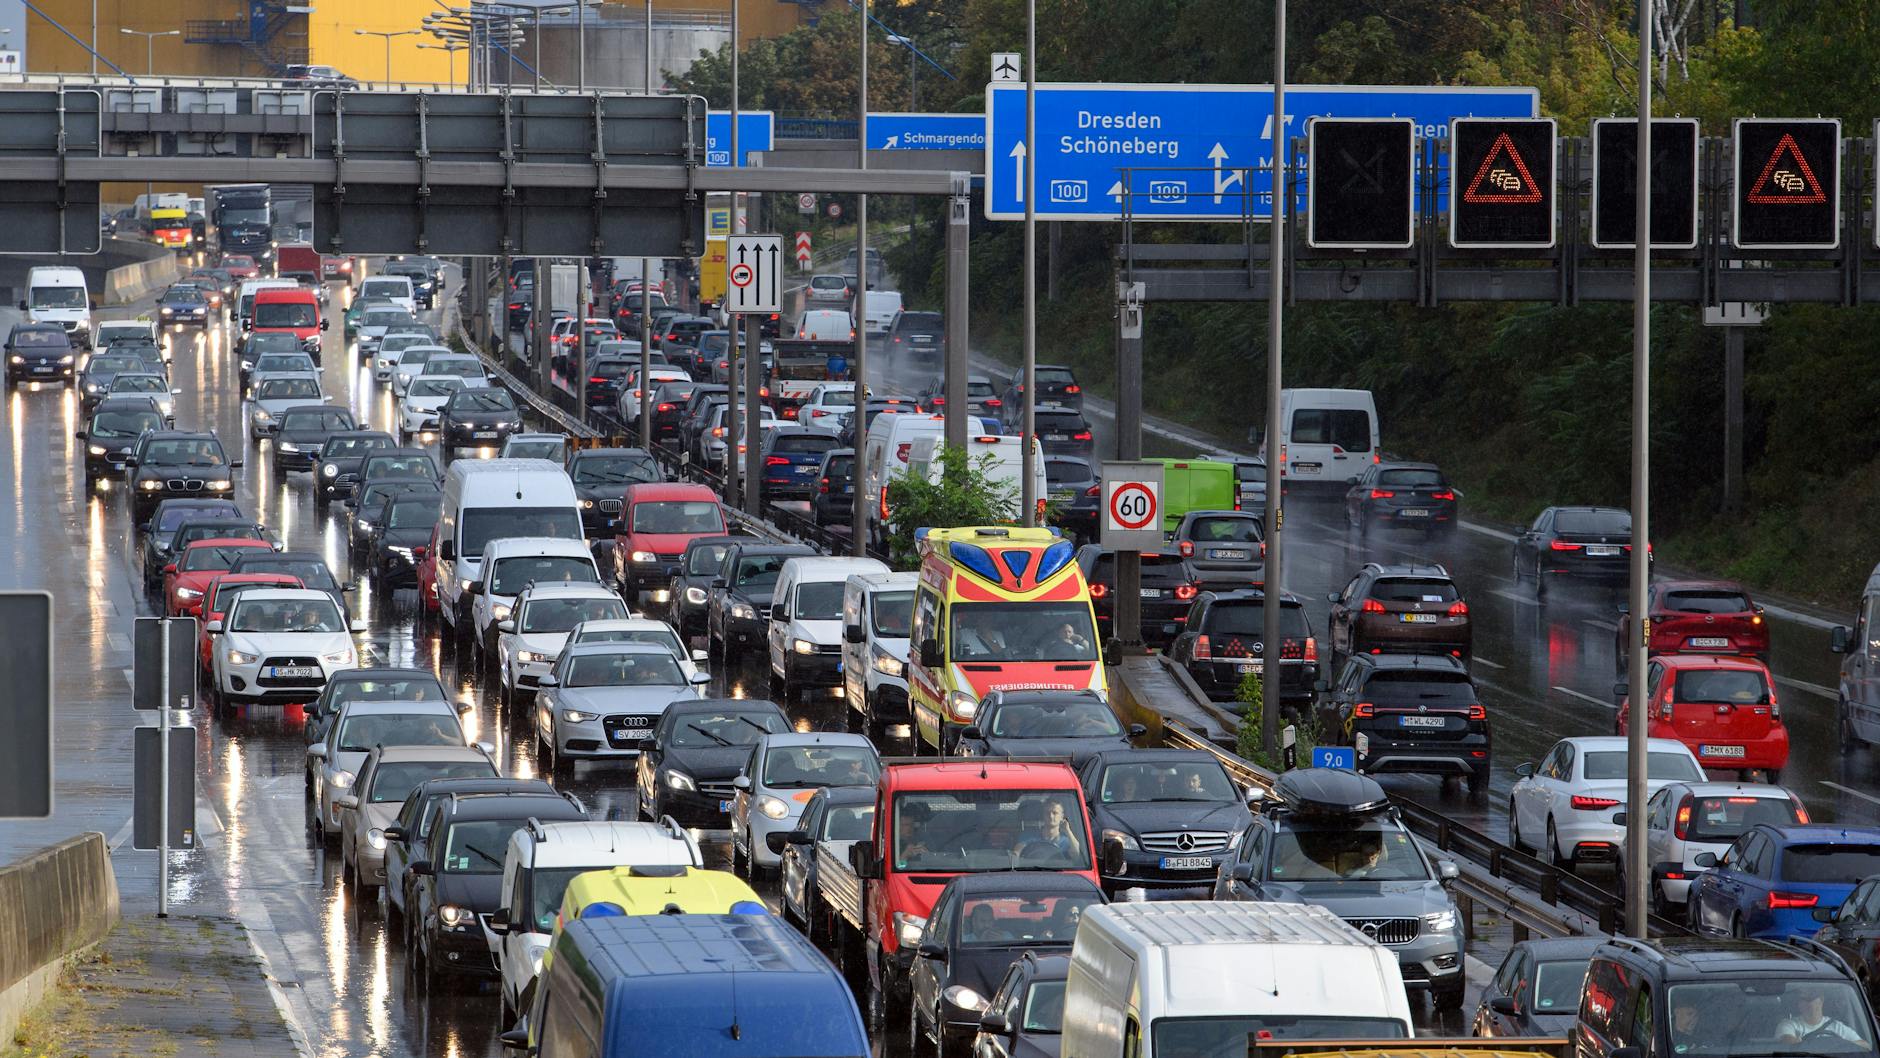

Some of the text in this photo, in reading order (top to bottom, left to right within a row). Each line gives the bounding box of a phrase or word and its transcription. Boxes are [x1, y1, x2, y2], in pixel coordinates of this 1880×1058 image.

[1078, 111, 1161, 129] Dresden
[1060, 136, 1179, 158] Schöneberg
[711, 154, 726, 162] 100
[1057, 185, 1081, 198] 100
[1155, 185, 1181, 199] 100
[1121, 496, 1146, 516] 60
[276, 669, 311, 677] OS HK 7022
[618, 730, 629, 738] SV
[1714, 746, 1723, 754] MX
[1324, 752, 1343, 768] 9,0
[1165, 858, 1211, 867] B FU 8845
